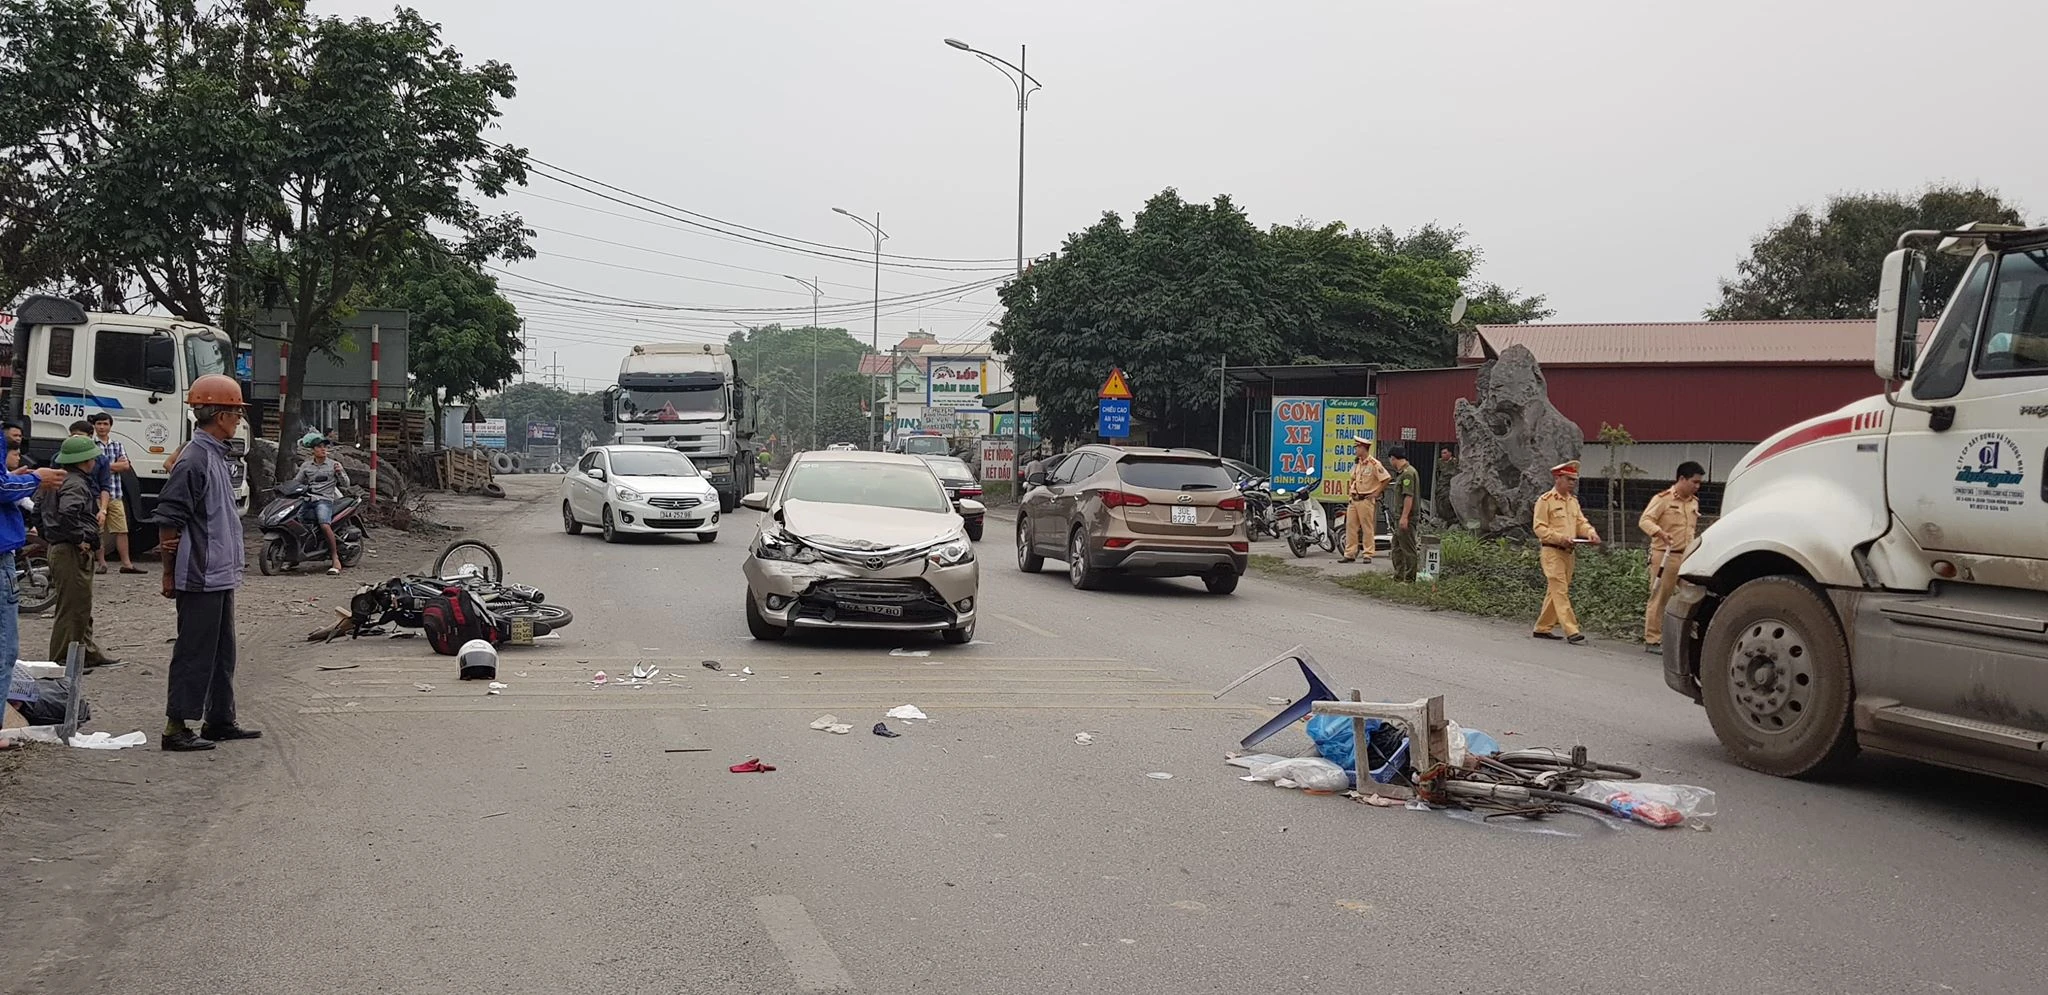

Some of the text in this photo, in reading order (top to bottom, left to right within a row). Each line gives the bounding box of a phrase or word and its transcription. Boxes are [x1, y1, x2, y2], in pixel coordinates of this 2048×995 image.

[959, 384, 979, 393] NAM
[33, 402, 85, 417] 34C-169.75
[1279, 401, 1320, 421] CƠM
[1348, 414, 1364, 425] THUI
[1285, 426, 1312, 444] XE
[1336, 426, 1354, 439] TRÂU
[1280, 447, 1315, 473] TẢI
[985, 464, 997, 479] KÉT
[1323, 480, 1343, 495] BIA
[1428, 552, 1437, 560] H1
[1430, 563, 1435, 571] 6
